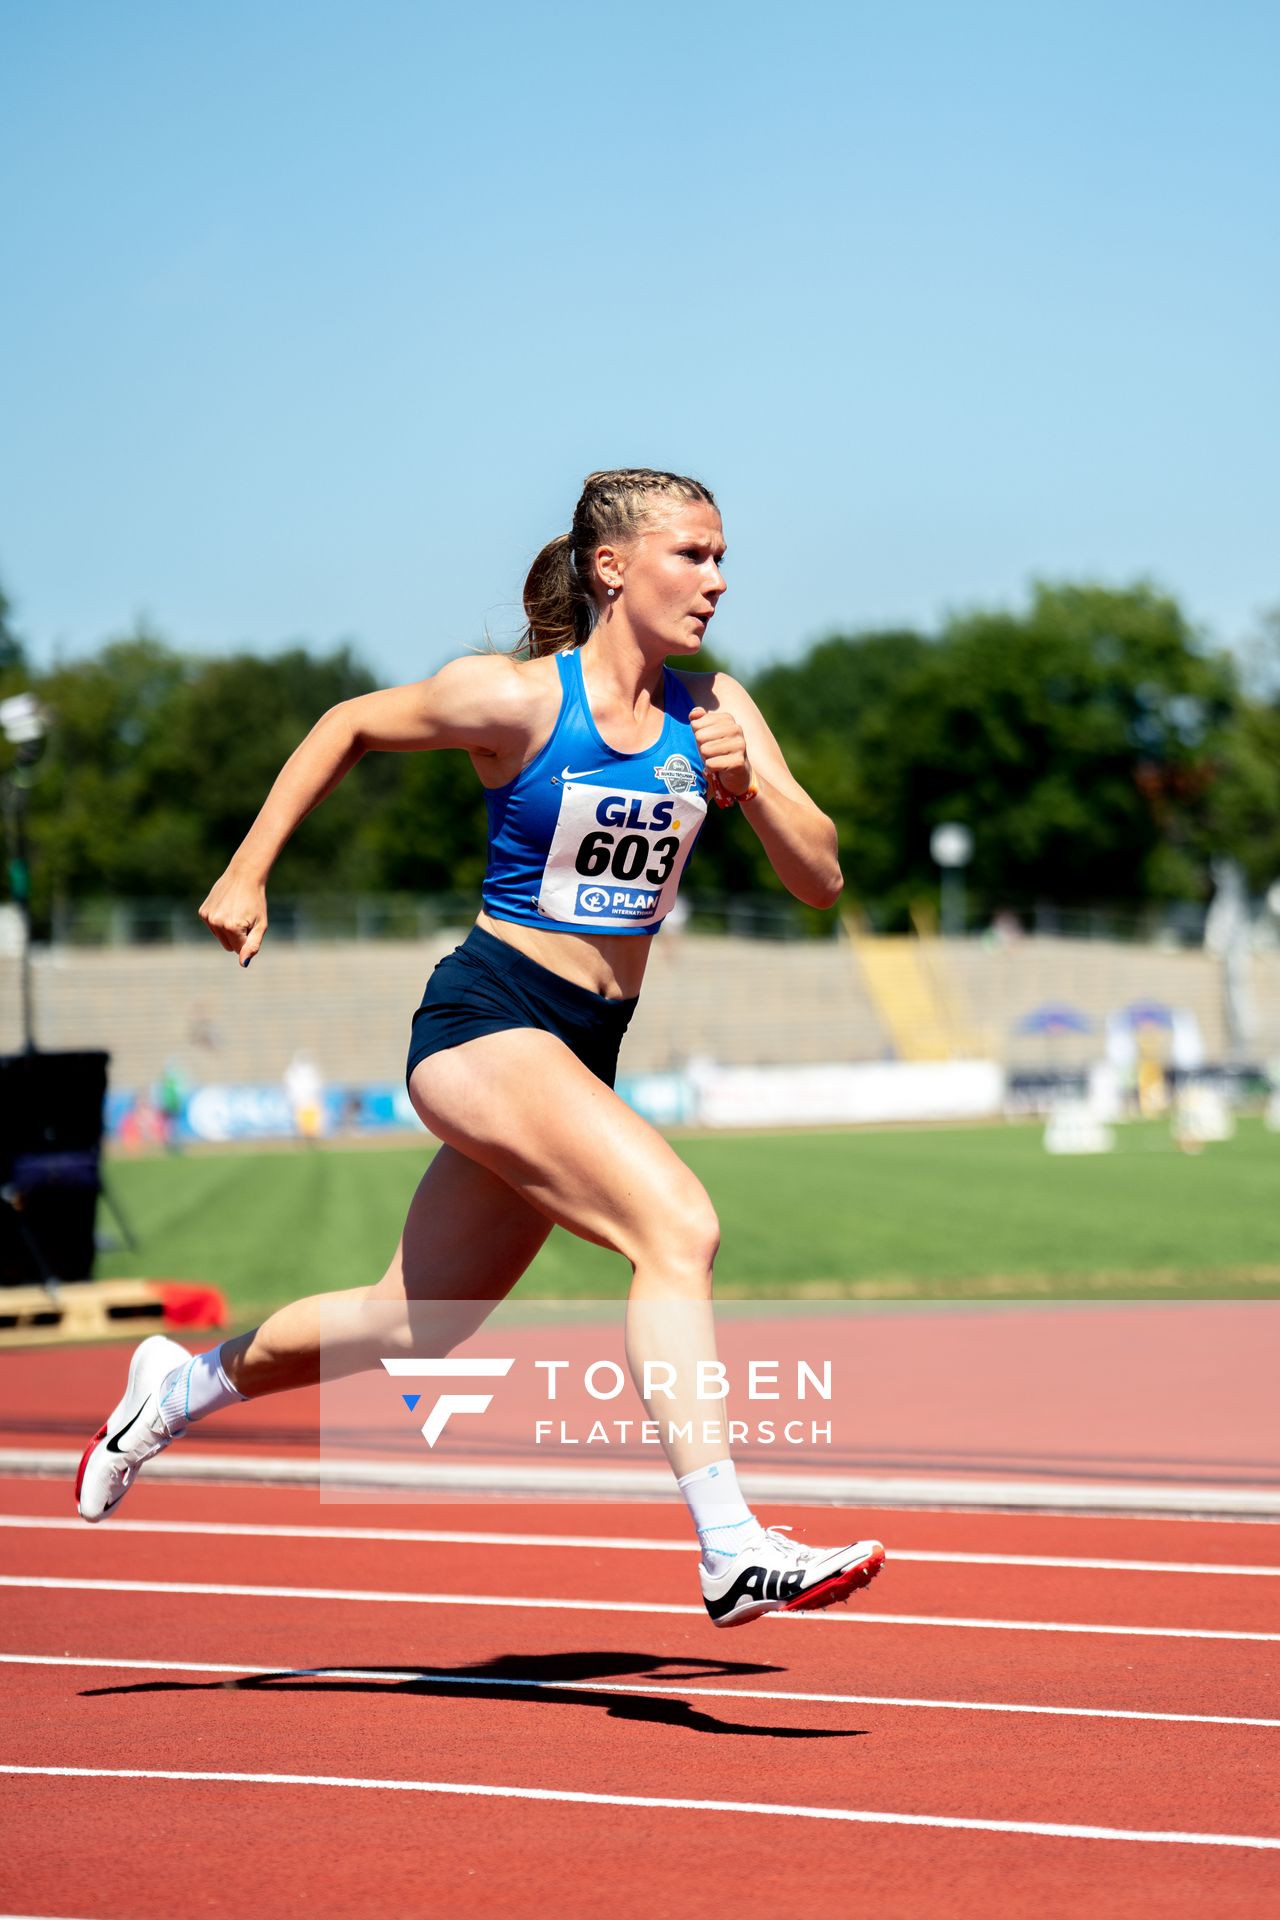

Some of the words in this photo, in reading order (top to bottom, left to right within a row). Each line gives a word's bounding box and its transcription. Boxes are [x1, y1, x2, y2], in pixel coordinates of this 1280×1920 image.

[574, 831, 680, 886] 603
[612, 892, 659, 910] PLAN
[733, 1565, 806, 1607] AIR
